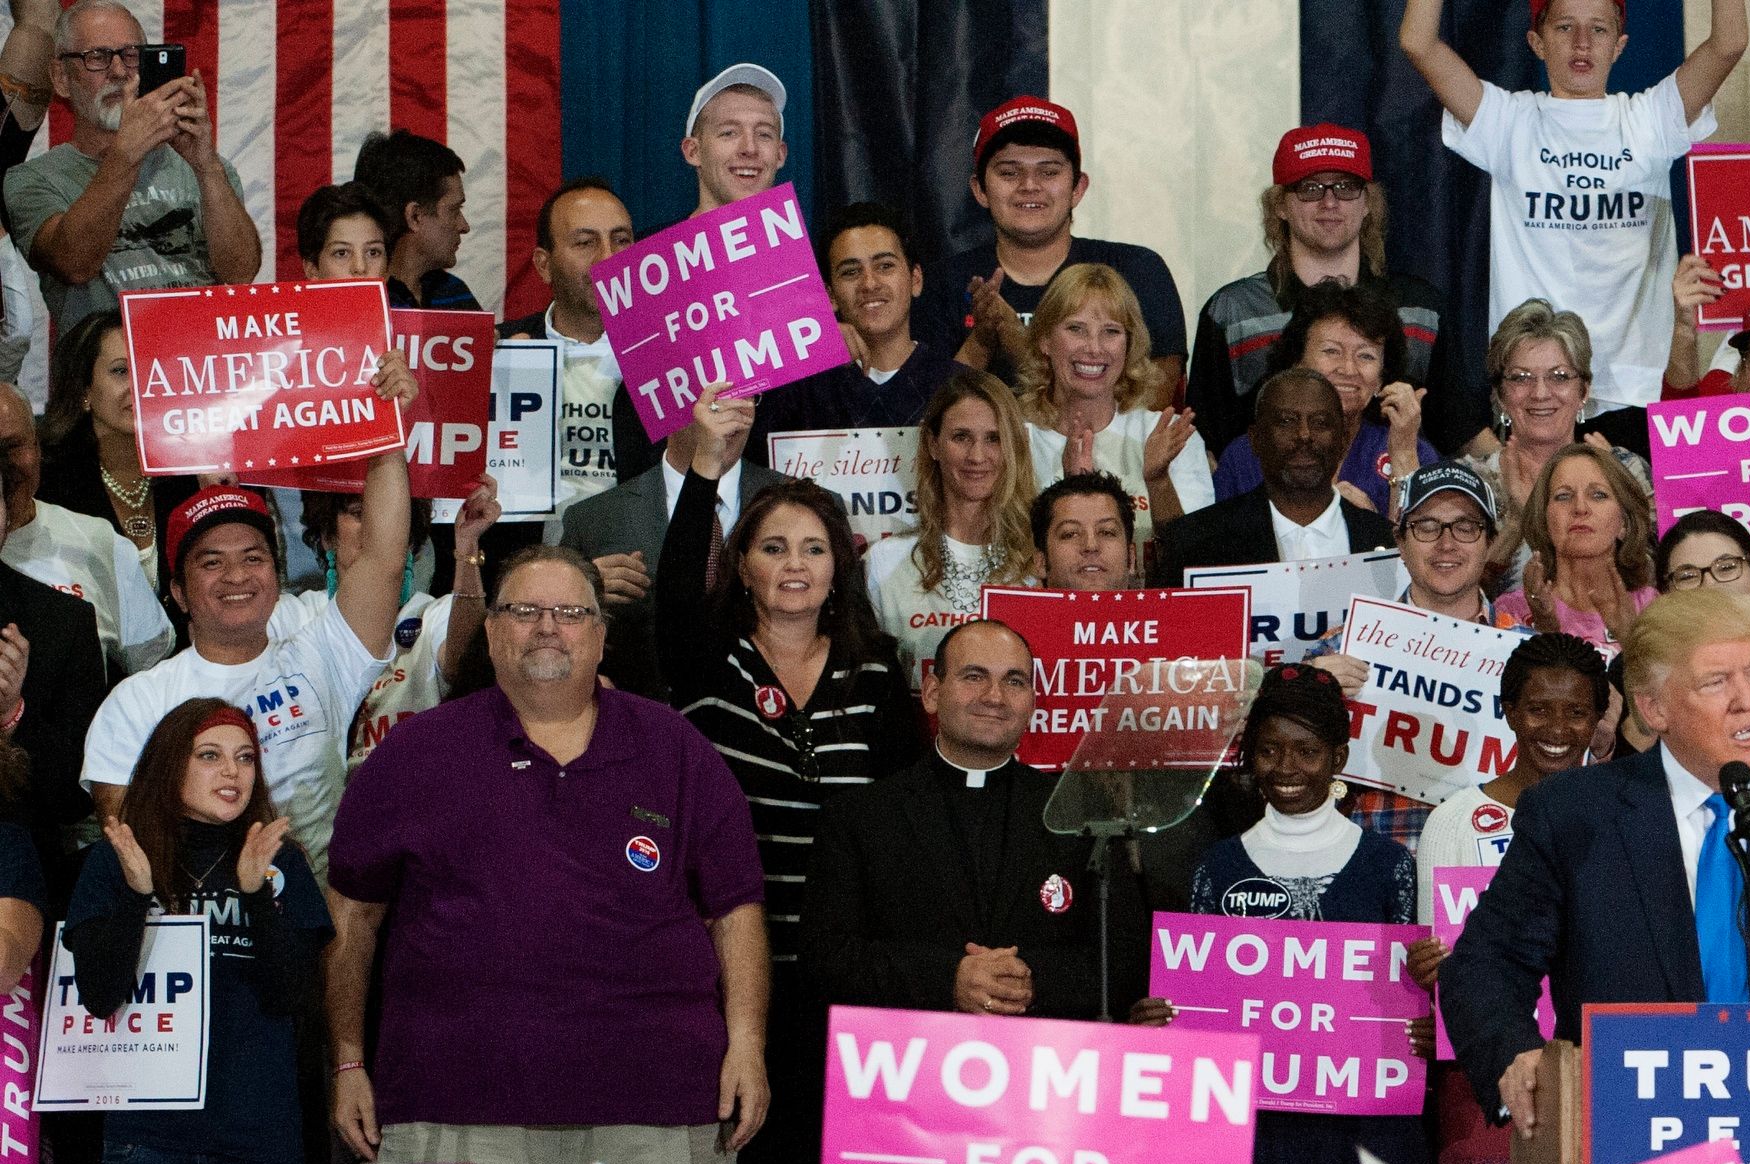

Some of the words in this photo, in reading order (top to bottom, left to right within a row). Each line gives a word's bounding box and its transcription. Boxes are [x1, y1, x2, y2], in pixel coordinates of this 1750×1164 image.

[1019, 107, 1060, 119] AMERICA
[1294, 139, 1319, 152] MAKE
[1320, 137, 1358, 150] AMERICA
[1299, 148, 1327, 160] GREAT
[1327, 148, 1355, 158] AGAIN
[1540, 148, 1633, 171] CATHOLICS
[1566, 174, 1605, 189] FOR
[1525, 191, 1644, 221] TRUMP
[1525, 221, 1545, 229] MAKE
[1549, 222, 1588, 231] AMERICA
[1591, 222, 1618, 231] GREAT
[596, 199, 804, 318] WOMEN
[216, 312, 301, 341] MAKE
[665, 292, 740, 343] FOR
[141, 344, 382, 398] AMERICA
[638, 317, 822, 422] TRUMP
[163, 404, 260, 437] GREAT
[273, 397, 378, 427] AGAIN
[566, 426, 609, 443] FOR
[784, 453, 823, 479] the
[830, 449, 902, 476] silent
[1419, 468, 1443, 480] MAKE
[1444, 467, 1480, 485] AMERICA
[185, 498, 209, 518] MAKE
[209, 494, 248, 505] AMERICA
[1073, 619, 1159, 645] MAKE
[1356, 619, 1398, 648] the
[1402, 628, 1472, 668] silent
[1033, 655, 1238, 699] MERICA
[1117, 704, 1219, 732] AGAIN
[1347, 700, 1518, 777] TRUM
[1227, 890, 1289, 909] TRUMP
[58, 972, 194, 1007] TMP
[62, 1013, 174, 1035] PENCE
[1242, 1000, 1335, 1032] FOR
[57, 1044, 76, 1054] MAKE
[77, 1043, 110, 1054] AMERICA
[111, 1043, 140, 1053] GREAT
[142, 1043, 180, 1052] AGAIN!
[836, 1032, 1253, 1125] WOMEN
[1263, 1052, 1409, 1100] UMP
[96, 1095, 120, 1105] 2016
